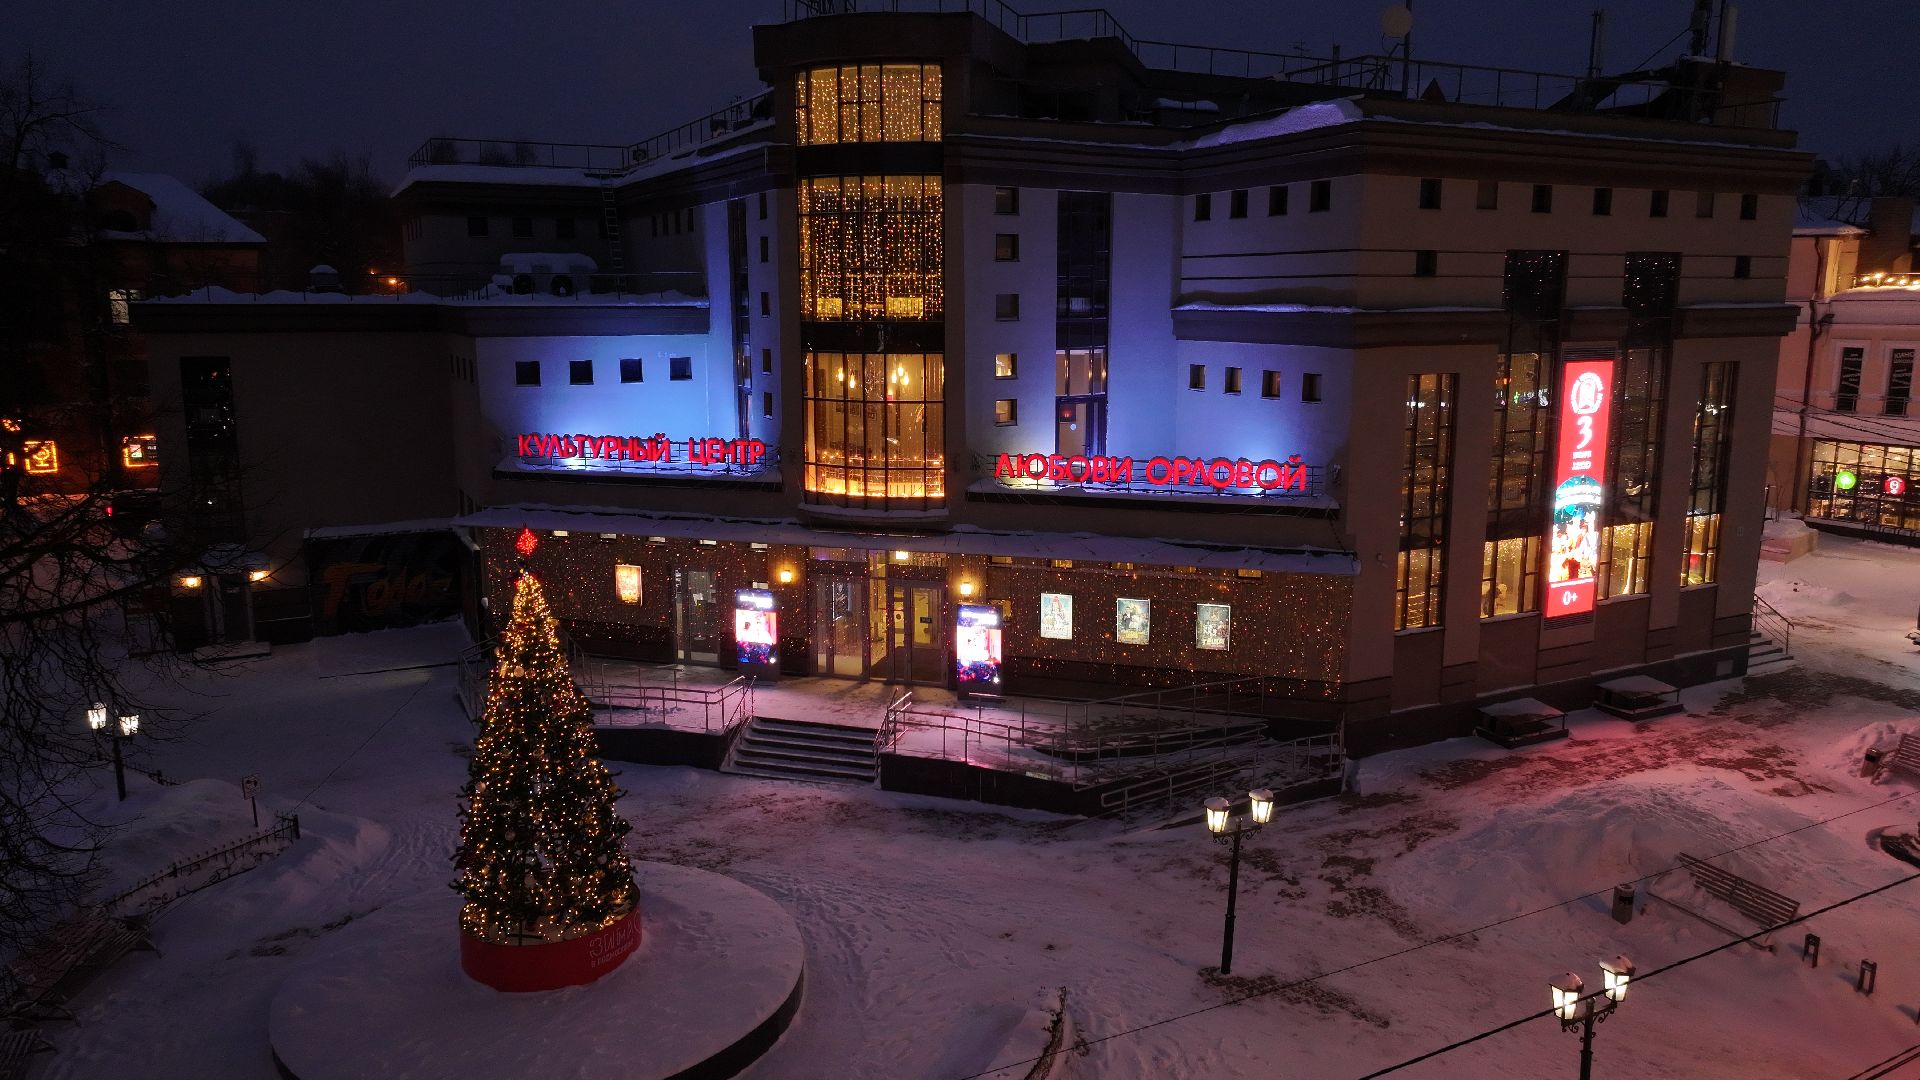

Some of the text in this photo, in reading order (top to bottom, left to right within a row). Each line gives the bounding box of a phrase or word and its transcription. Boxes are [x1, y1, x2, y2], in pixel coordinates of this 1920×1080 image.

[518, 433, 767, 466] КУЛЬТУРНЫЙ ЦЕНТР
[1577, 416, 1593, 450] 3
[994, 452, 1306, 491] ЛЮБОВИ ОРЛОВОЙ
[1562, 590, 1579, 606] 0+
